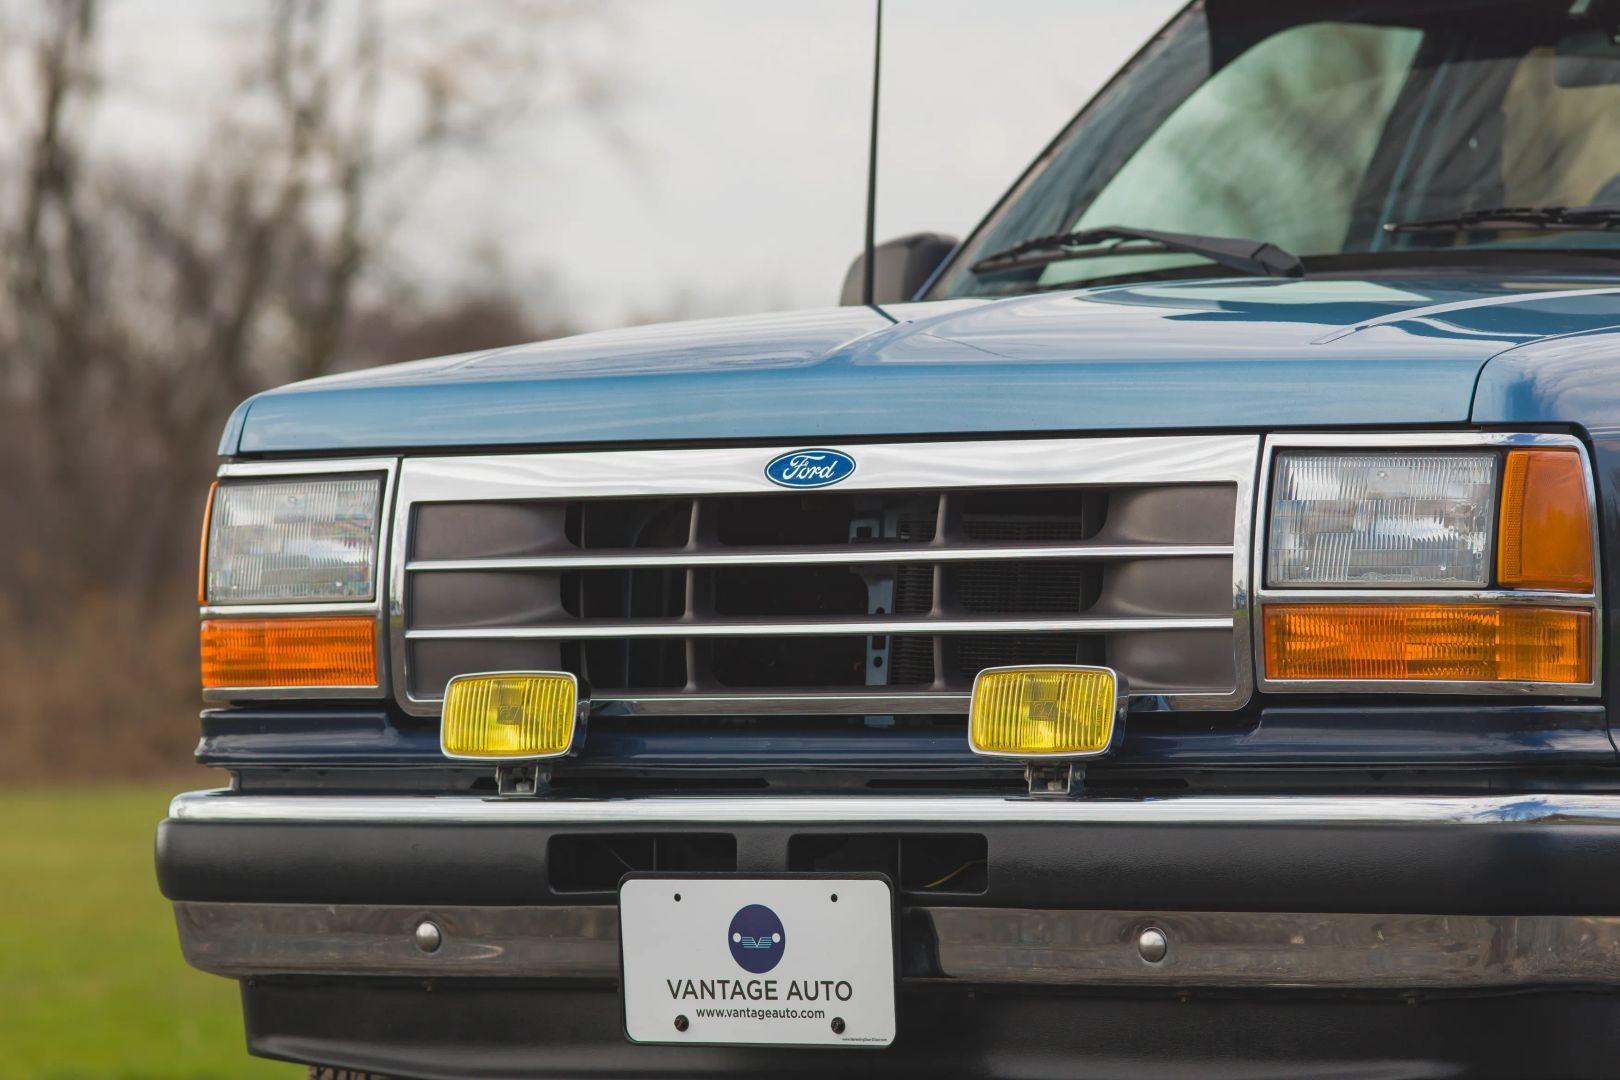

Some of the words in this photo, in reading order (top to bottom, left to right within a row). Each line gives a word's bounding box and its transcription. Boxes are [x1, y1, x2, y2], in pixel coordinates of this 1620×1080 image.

[782, 455, 838, 480] Ford
[666, 979, 778, 1001] VANTAGE
[786, 980, 853, 1002] AUTO
[695, 1008, 825, 1020] www.vantageauto.com
